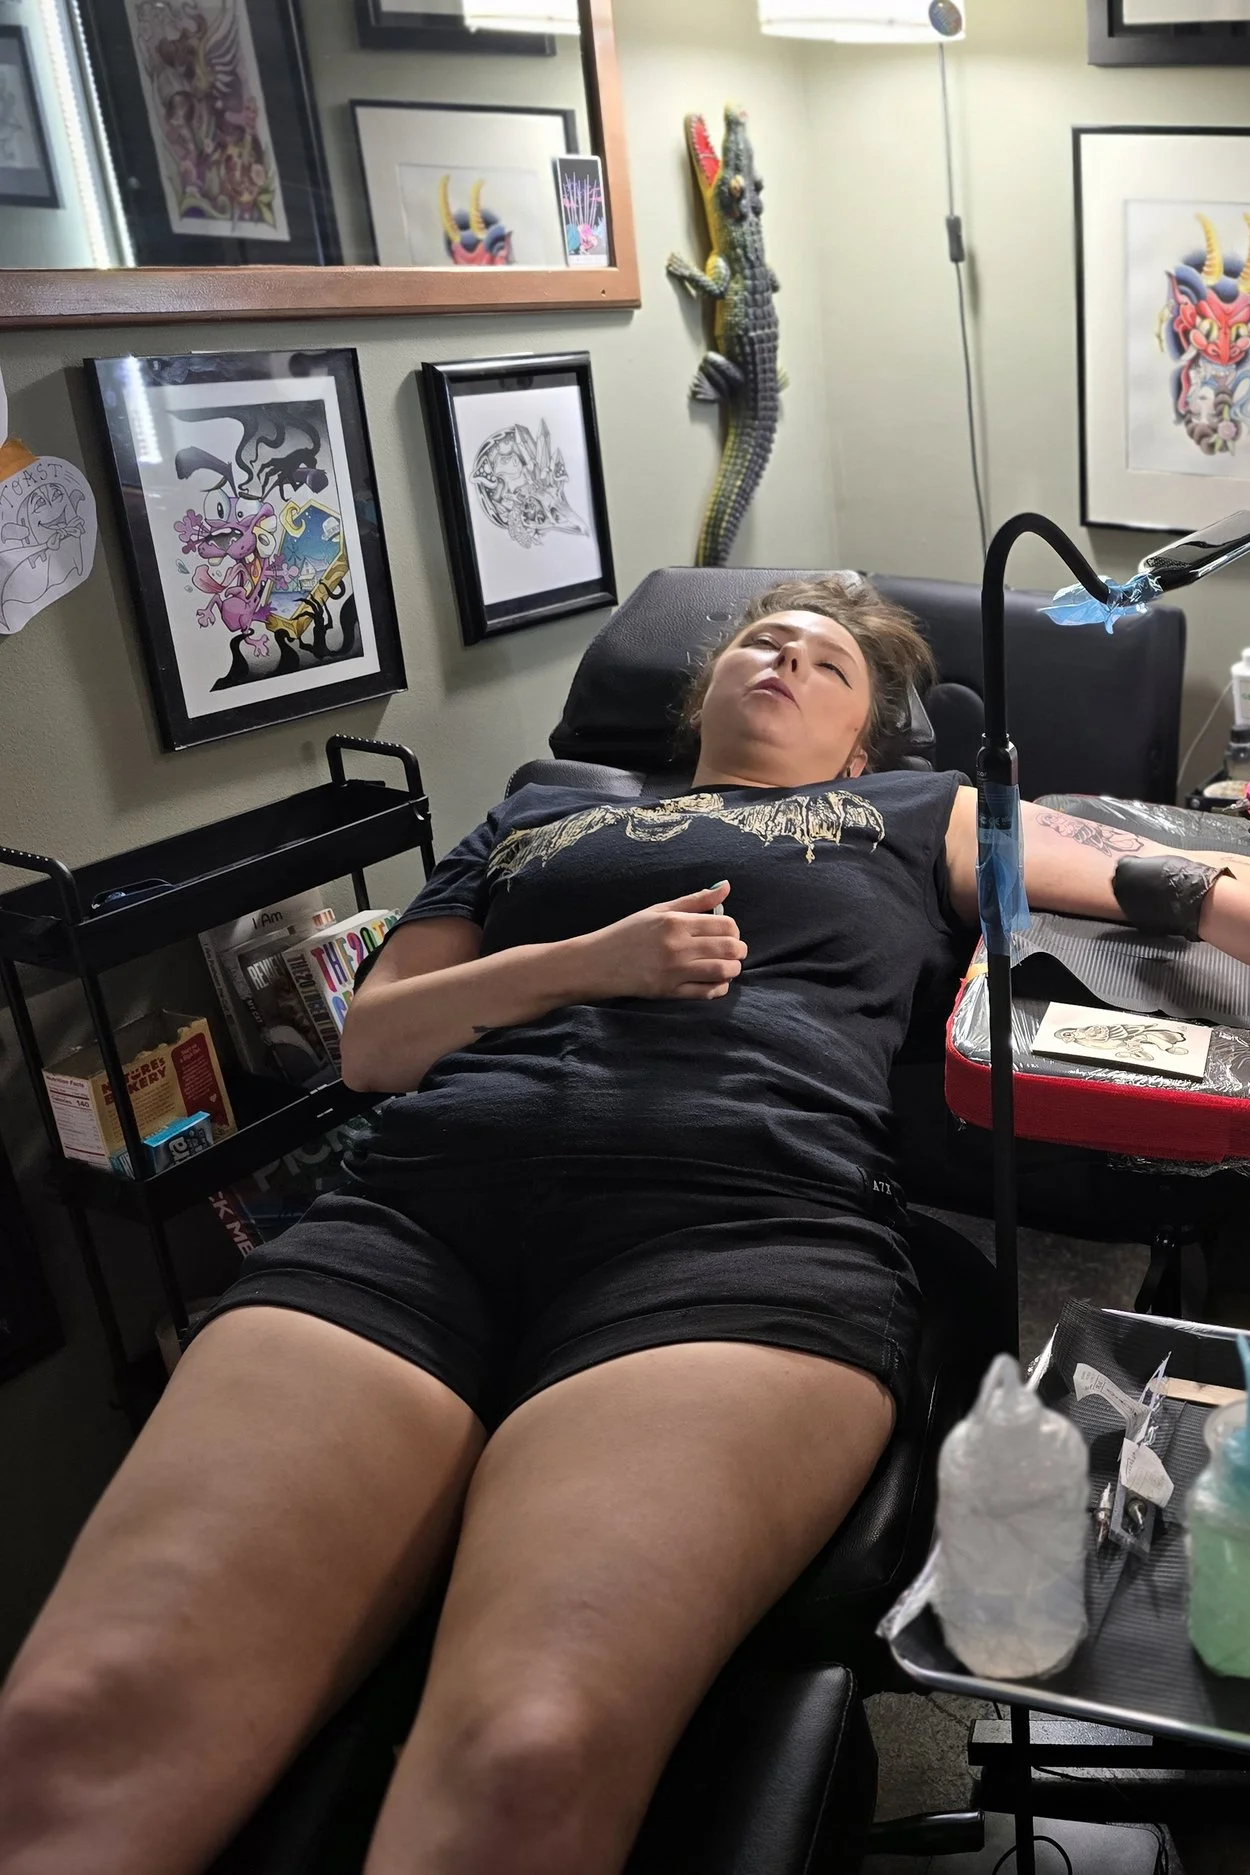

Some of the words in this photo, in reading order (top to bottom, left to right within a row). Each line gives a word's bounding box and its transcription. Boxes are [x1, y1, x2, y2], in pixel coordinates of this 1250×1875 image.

[0, 463, 63, 508] TOAST
[261, 910, 284, 928] Am
[104, 1064, 167, 1106] BKERY
[225, 1220, 258, 1259] ME
